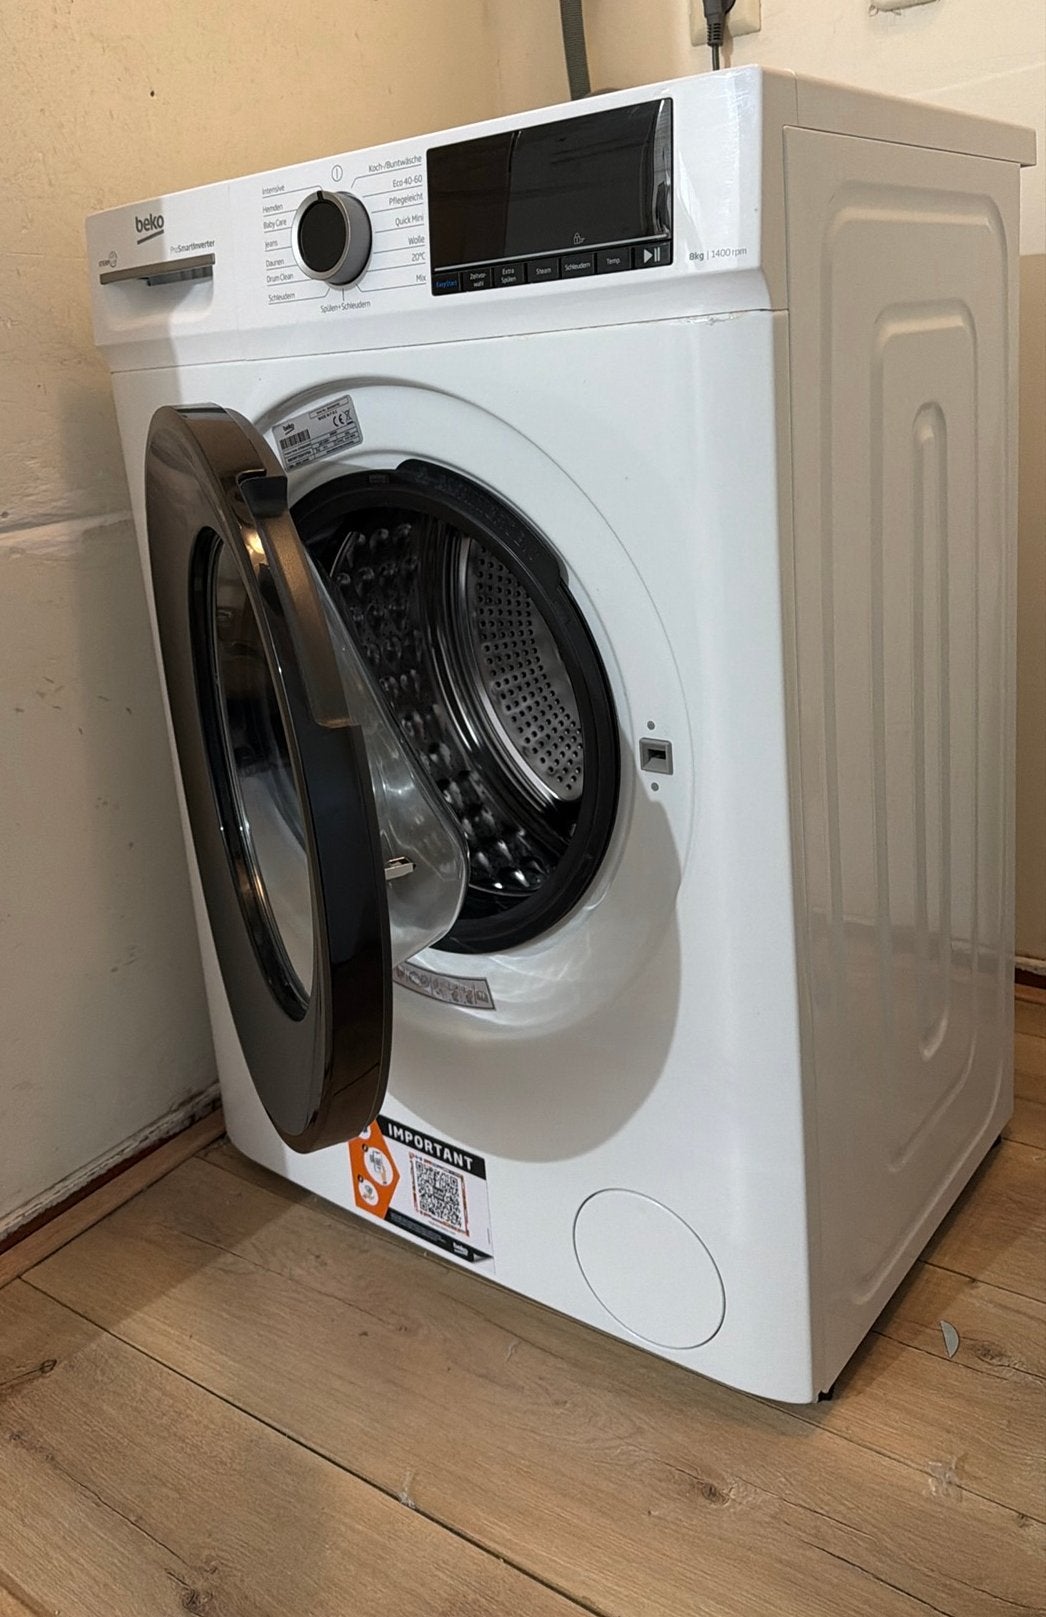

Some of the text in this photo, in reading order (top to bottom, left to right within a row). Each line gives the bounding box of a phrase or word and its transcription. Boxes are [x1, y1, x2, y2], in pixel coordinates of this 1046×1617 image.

[368, 155, 422, 172] Koch-/Buntwäsche
[393, 175, 423, 188] Eco 40-60
[262, 184, 285, 195] Intensive
[389, 192, 423, 206] Pflegeleicht
[262, 203, 283, 214] Hemden
[135, 213, 165, 233] beko
[263, 218, 287, 231] Baby Care
[395, 214, 424, 227] Quick Mini
[264, 239, 279, 249] Jeans
[408, 235, 425, 245] Wolle
[411, 251, 425, 262] 20°C
[689, 247, 747, 262] 8kg 1400 rpm
[266, 259, 284, 268] Daunen
[564, 262, 591, 271] Schleudern
[535, 267, 552, 275] Steam
[266, 272, 294, 283] Drum Clean
[415, 274, 426, 282] Mix
[268, 291, 295, 302] Schleudern
[388, 1122, 473, 1171] IMPORTANT
